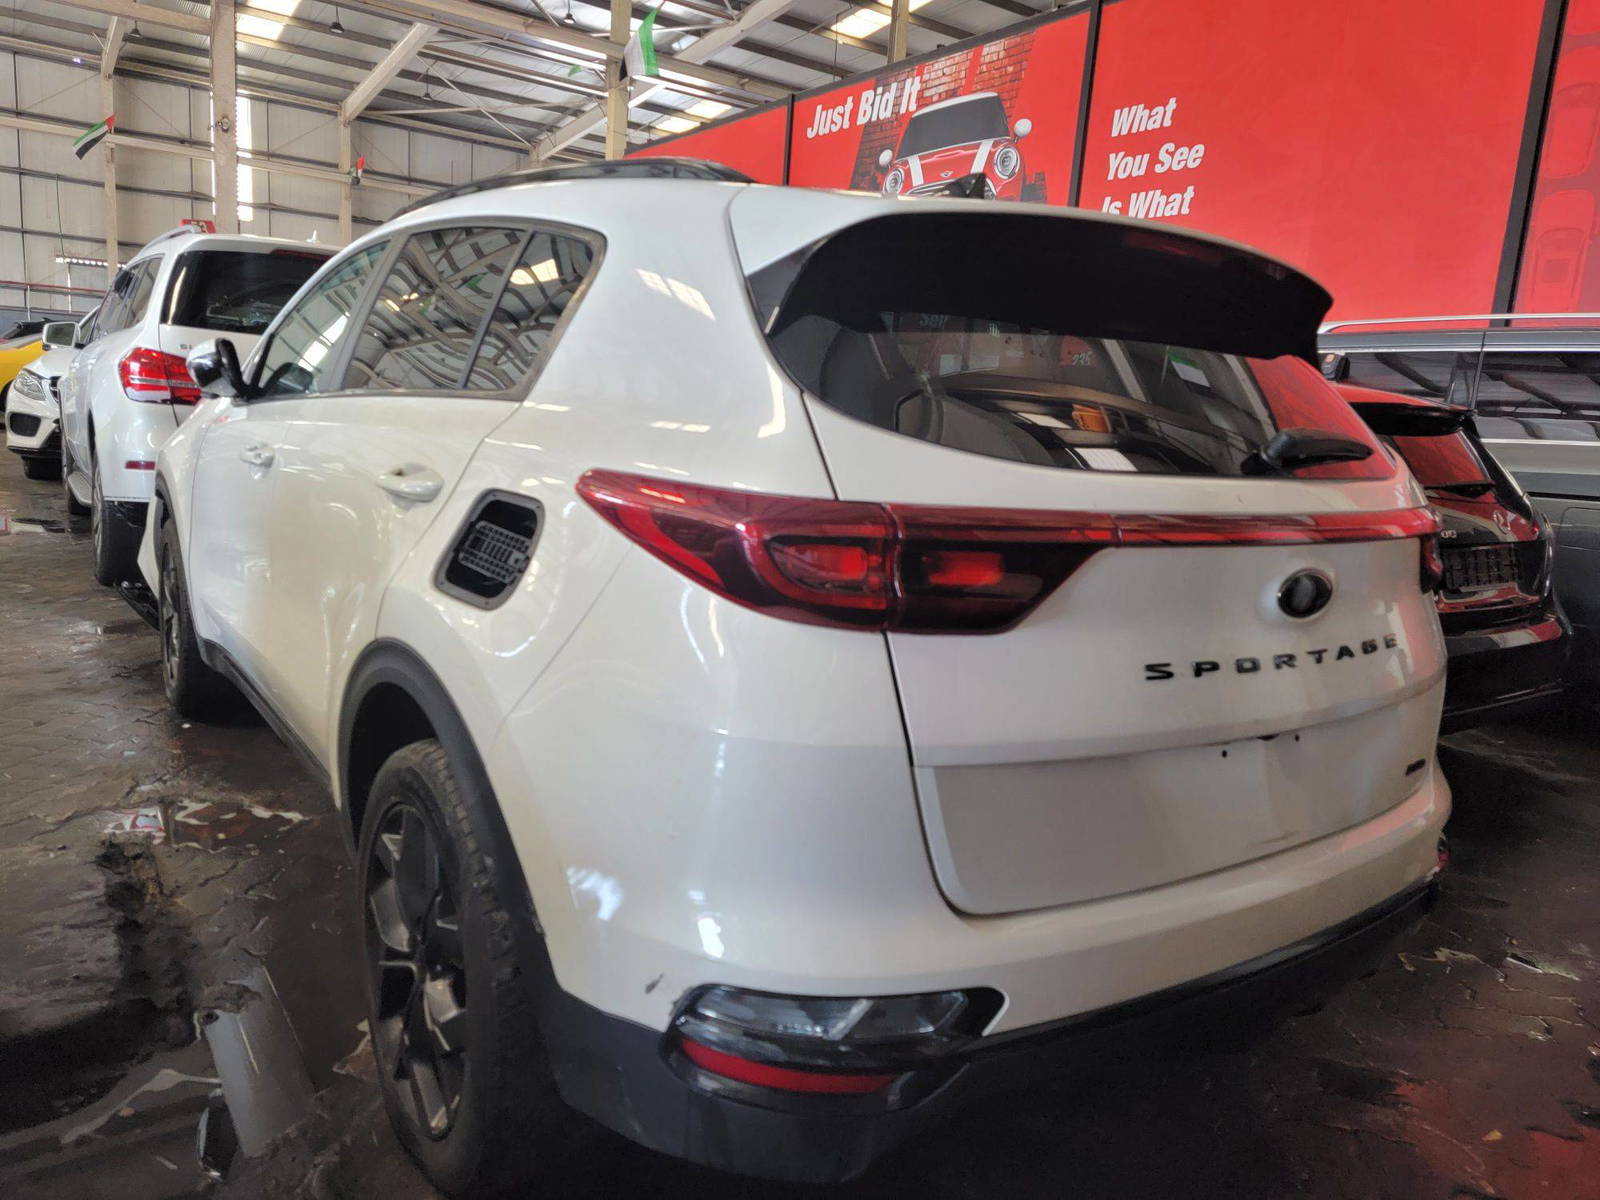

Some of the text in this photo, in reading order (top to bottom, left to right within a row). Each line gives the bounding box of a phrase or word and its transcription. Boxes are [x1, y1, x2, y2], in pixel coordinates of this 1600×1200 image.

[807, 76, 921, 138] Just Bid It
[1111, 97, 1177, 137] What
[1107, 142, 1205, 181] You See
[1102, 185, 1195, 219] Is What
[1145, 633, 1398, 681] SPORTAGE
